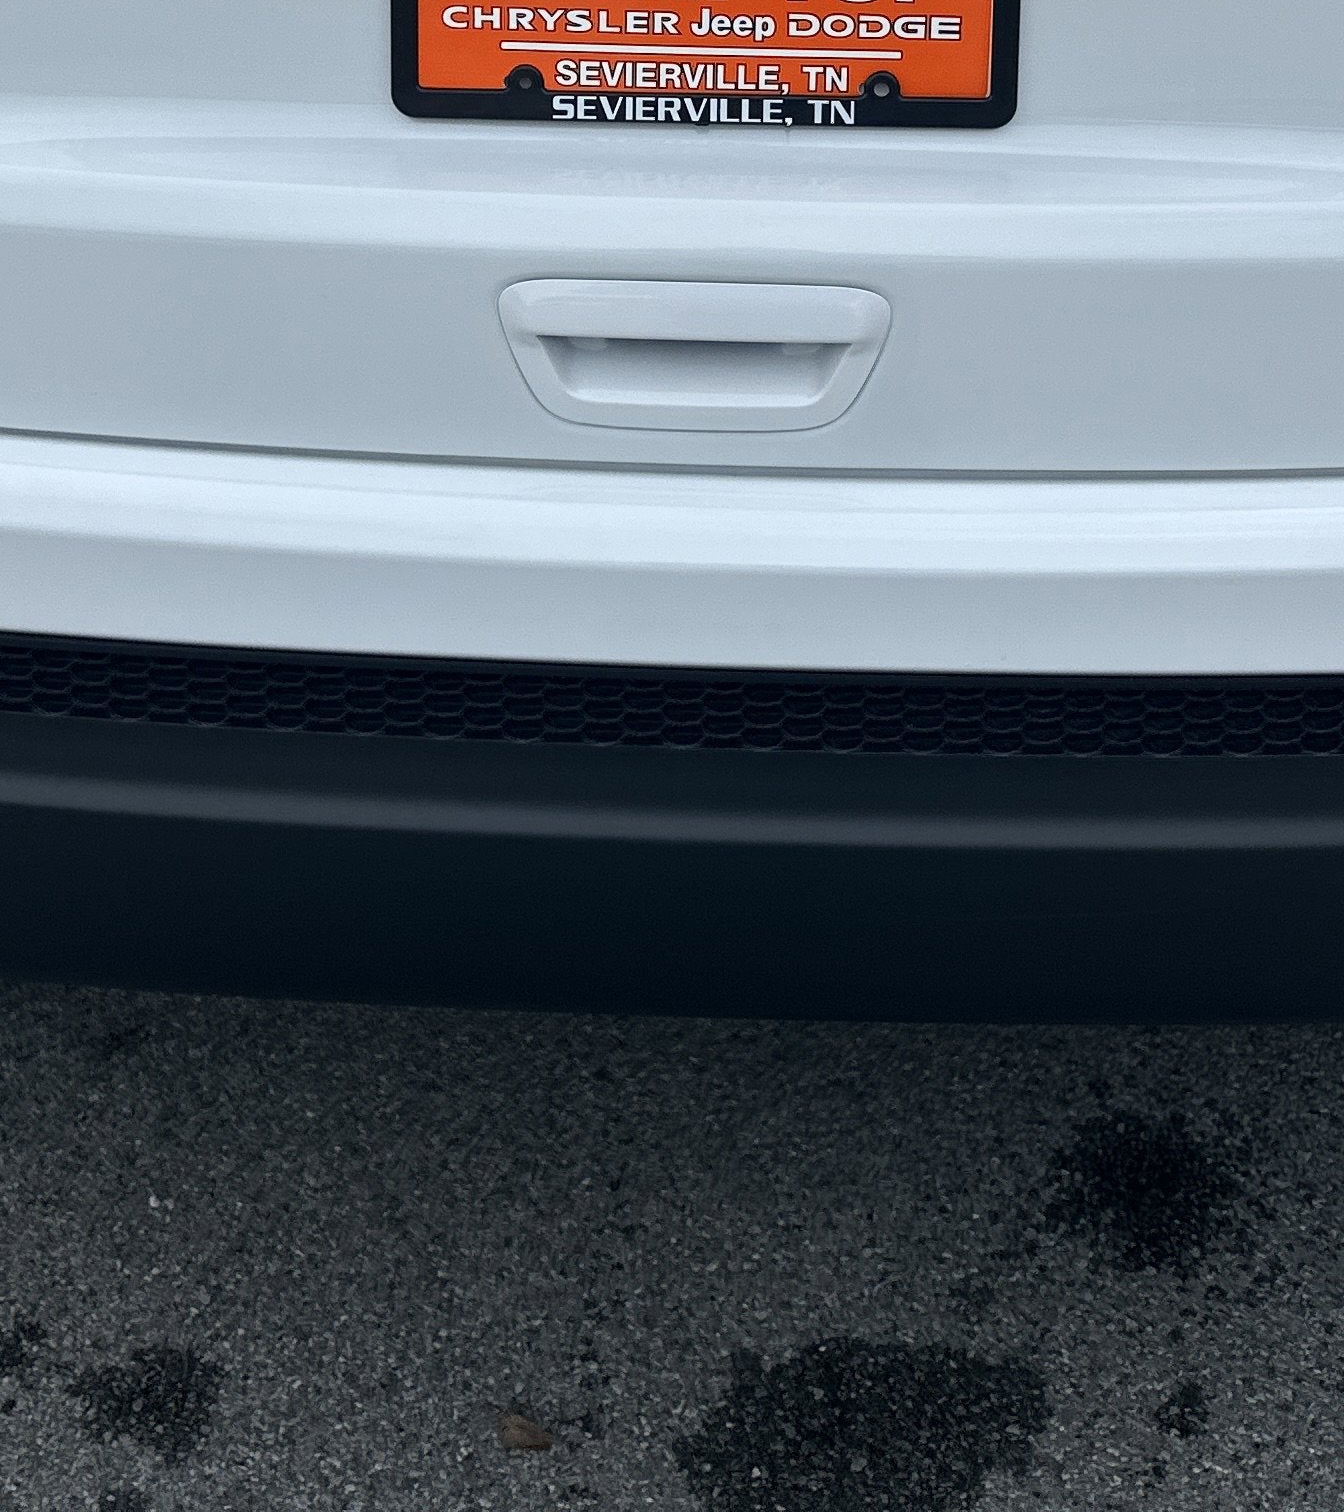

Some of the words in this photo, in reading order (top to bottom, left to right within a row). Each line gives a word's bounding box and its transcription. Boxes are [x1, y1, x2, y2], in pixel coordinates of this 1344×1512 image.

[442, 6, 680, 35] CHRYSLER
[691, 7, 776, 41] Jeep
[787, 13, 962, 40] DODGE
[555, 59, 790, 95] SEVIERVILLE,
[801, 65, 850, 92] TN
[552, 94, 793, 126] SEVIERVILLE,
[807, 98, 855, 125] TN
